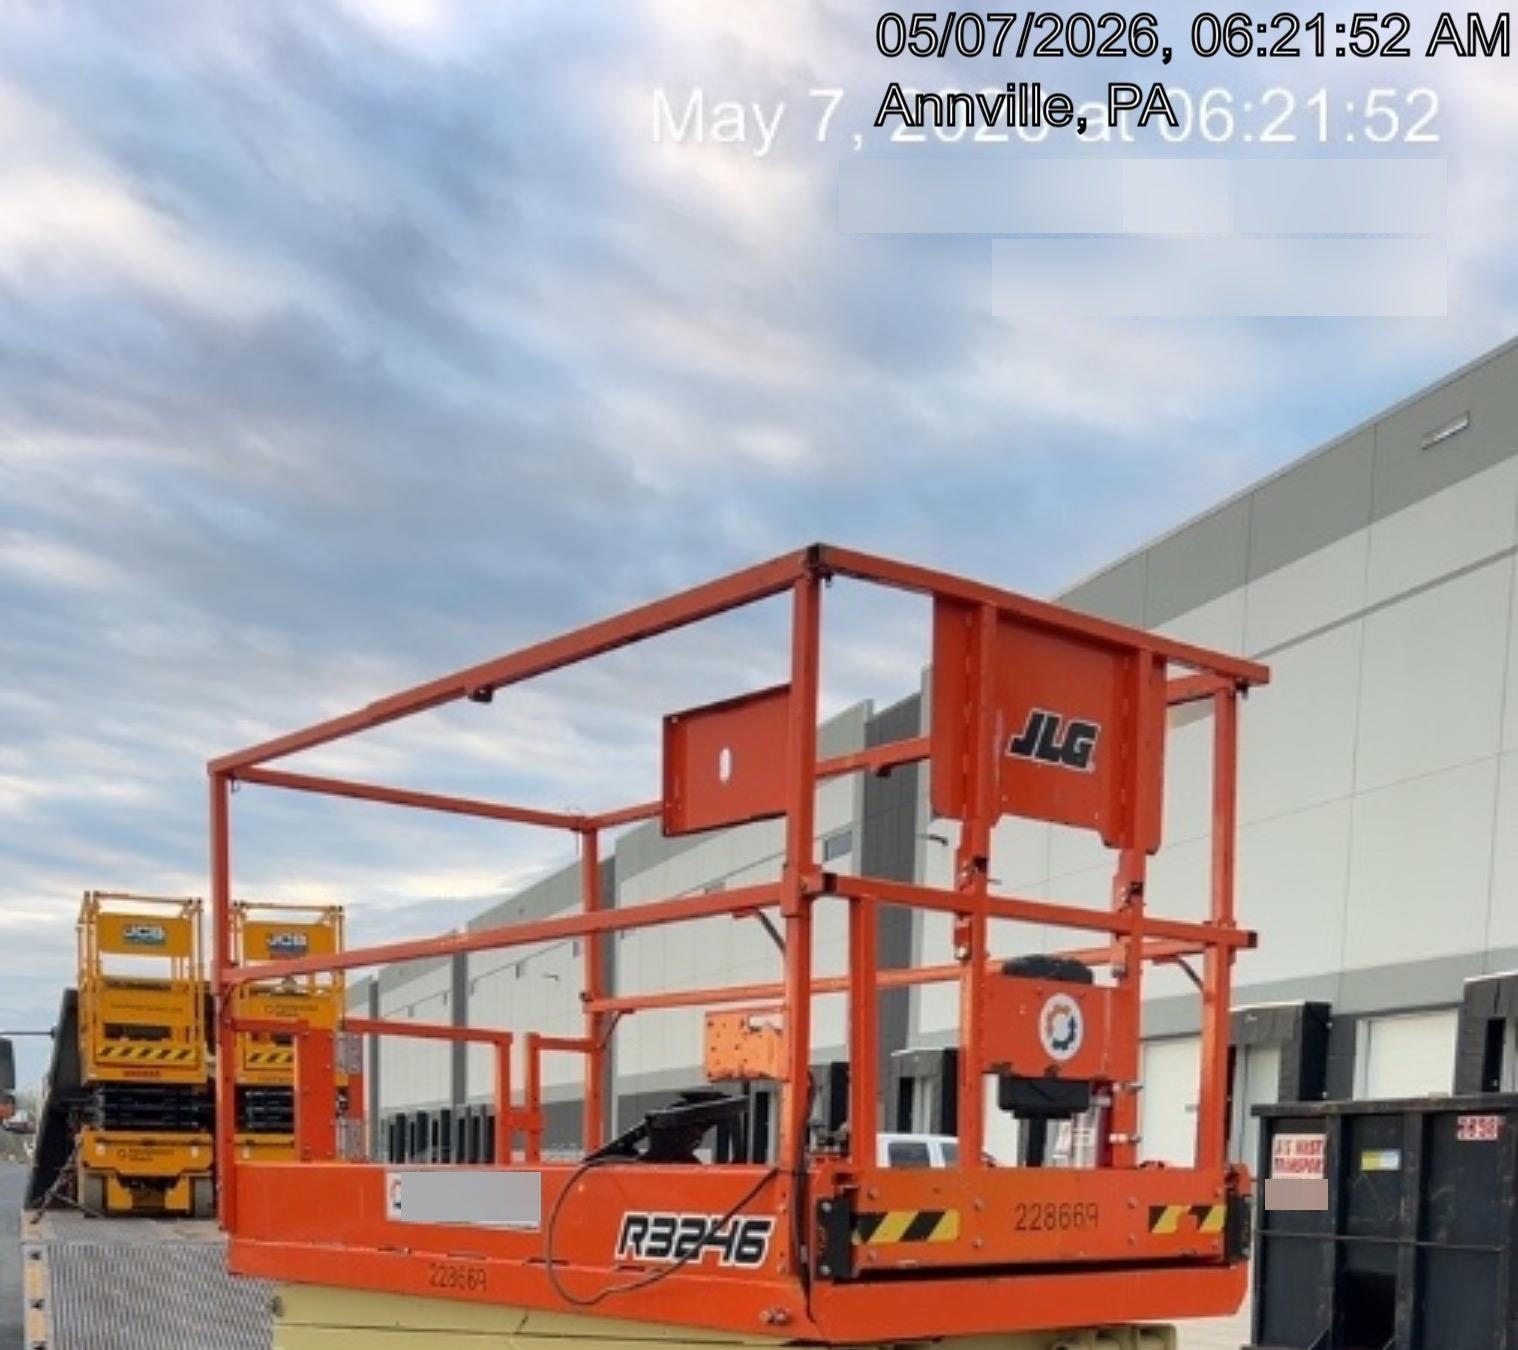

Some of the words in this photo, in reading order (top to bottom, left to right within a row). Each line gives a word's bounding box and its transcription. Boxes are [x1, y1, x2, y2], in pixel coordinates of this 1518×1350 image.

[1005, 707, 1101, 773] JLG
[614, 1209, 776, 1269] R3246
[1014, 1202, 1099, 1232] 228669
